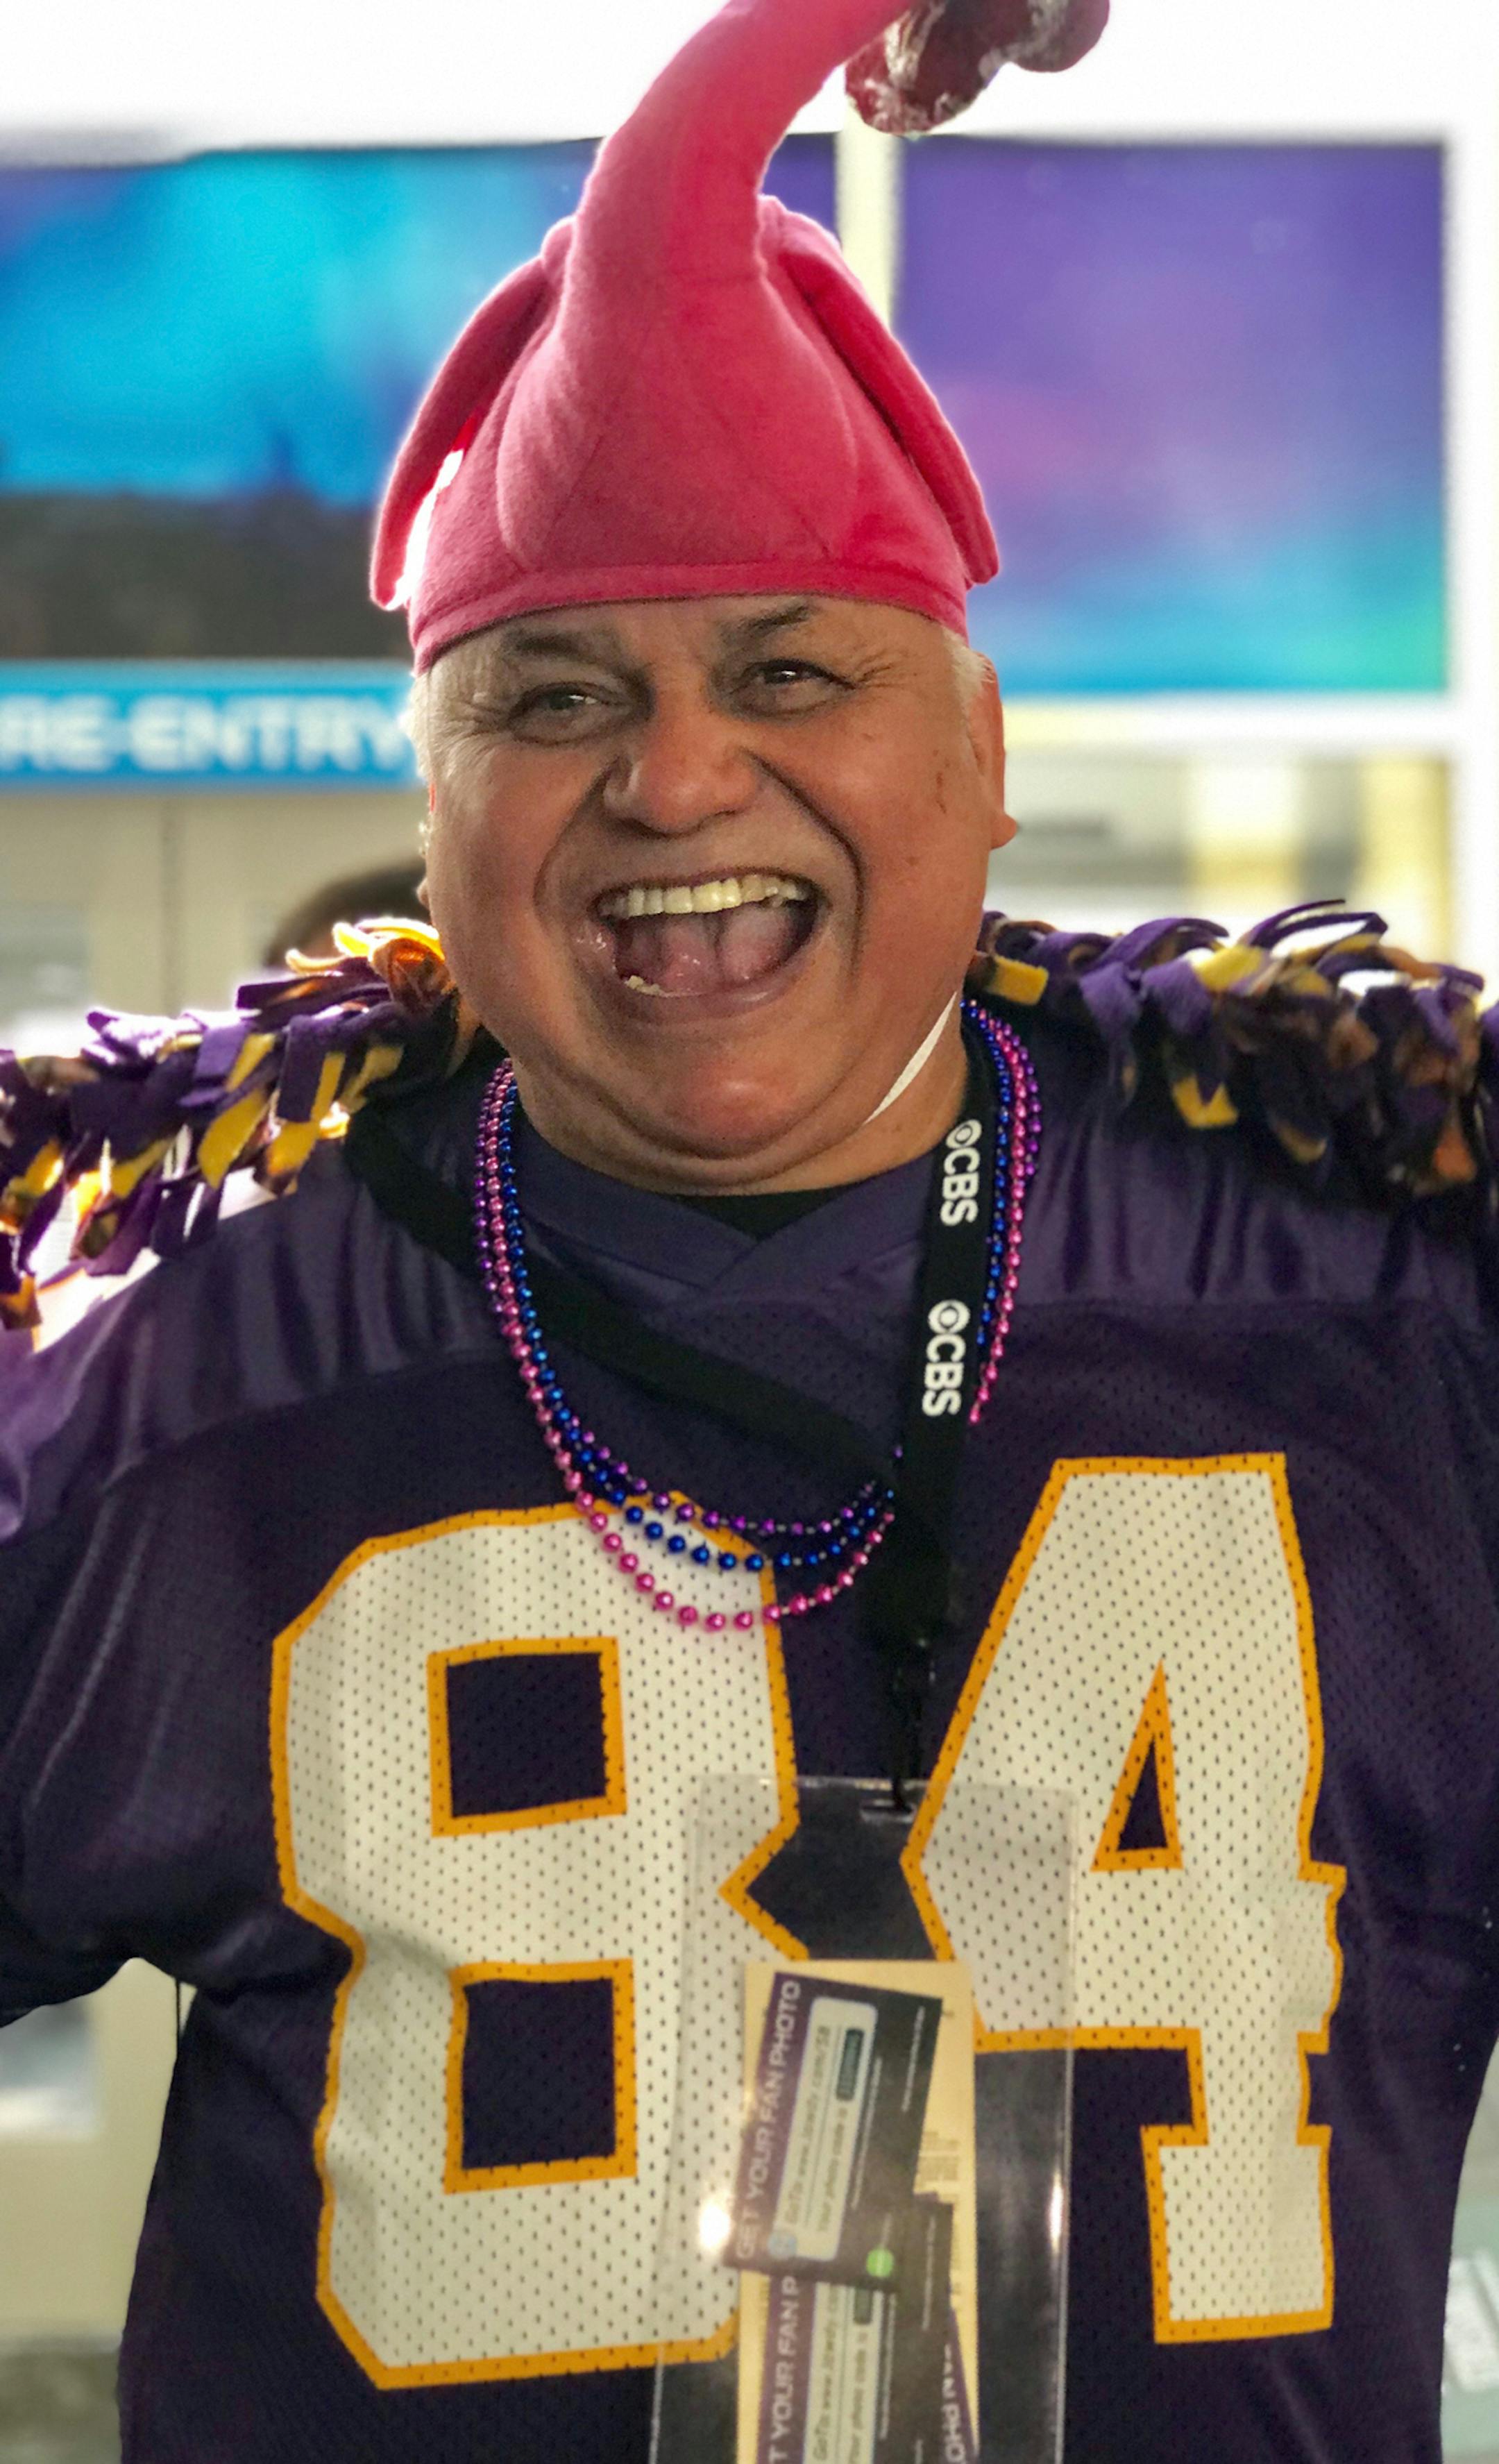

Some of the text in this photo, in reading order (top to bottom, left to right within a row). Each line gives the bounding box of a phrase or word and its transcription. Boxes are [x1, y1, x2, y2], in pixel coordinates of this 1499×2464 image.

[0, 696, 411, 770] RE-ENTRY
[940, 1148, 981, 1226] CBS
[922, 1334, 966, 1417] CBS
[269, 1452, 1345, 2389] 84
[736, 1979, 801, 2261] GET YOUR FAN PHOTO
[777, 2300, 799, 2356] FAN
[770, 2361, 795, 2440] YOUR
